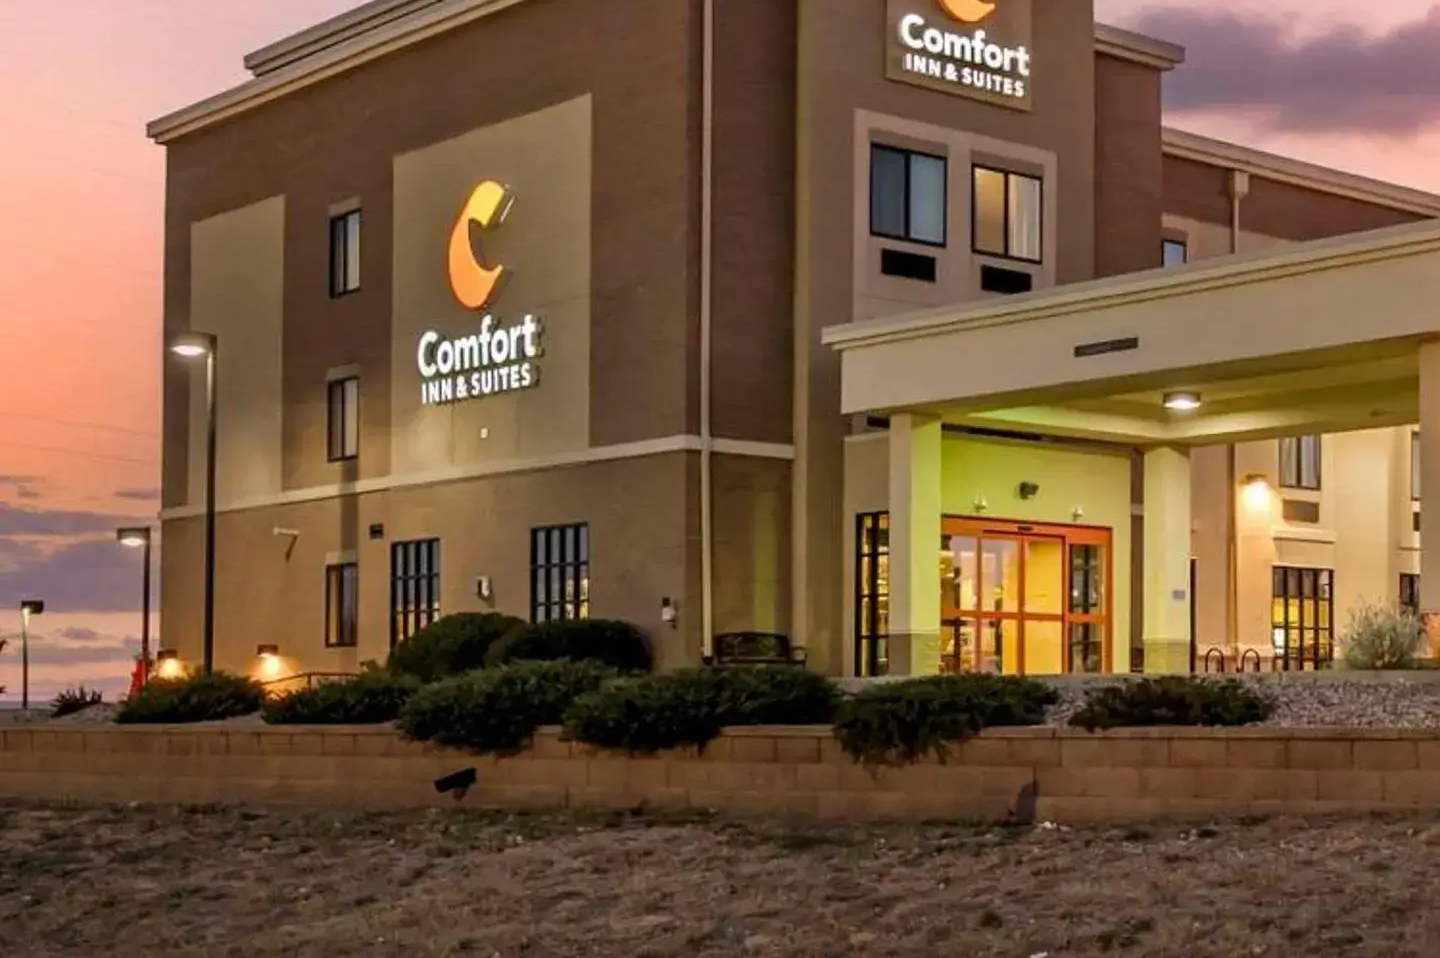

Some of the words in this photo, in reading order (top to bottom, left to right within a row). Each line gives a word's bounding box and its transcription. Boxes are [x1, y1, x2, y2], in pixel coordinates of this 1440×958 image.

[900, 13, 1030, 76] Comfort
[903, 53, 941, 78] INN
[944, 62, 959, 82] &
[961, 67, 1025, 97] SUITES
[418, 314, 536, 377] Comfort
[421, 377, 453, 405] INN
[456, 374, 469, 399] &
[471, 363, 532, 396] SUITES
